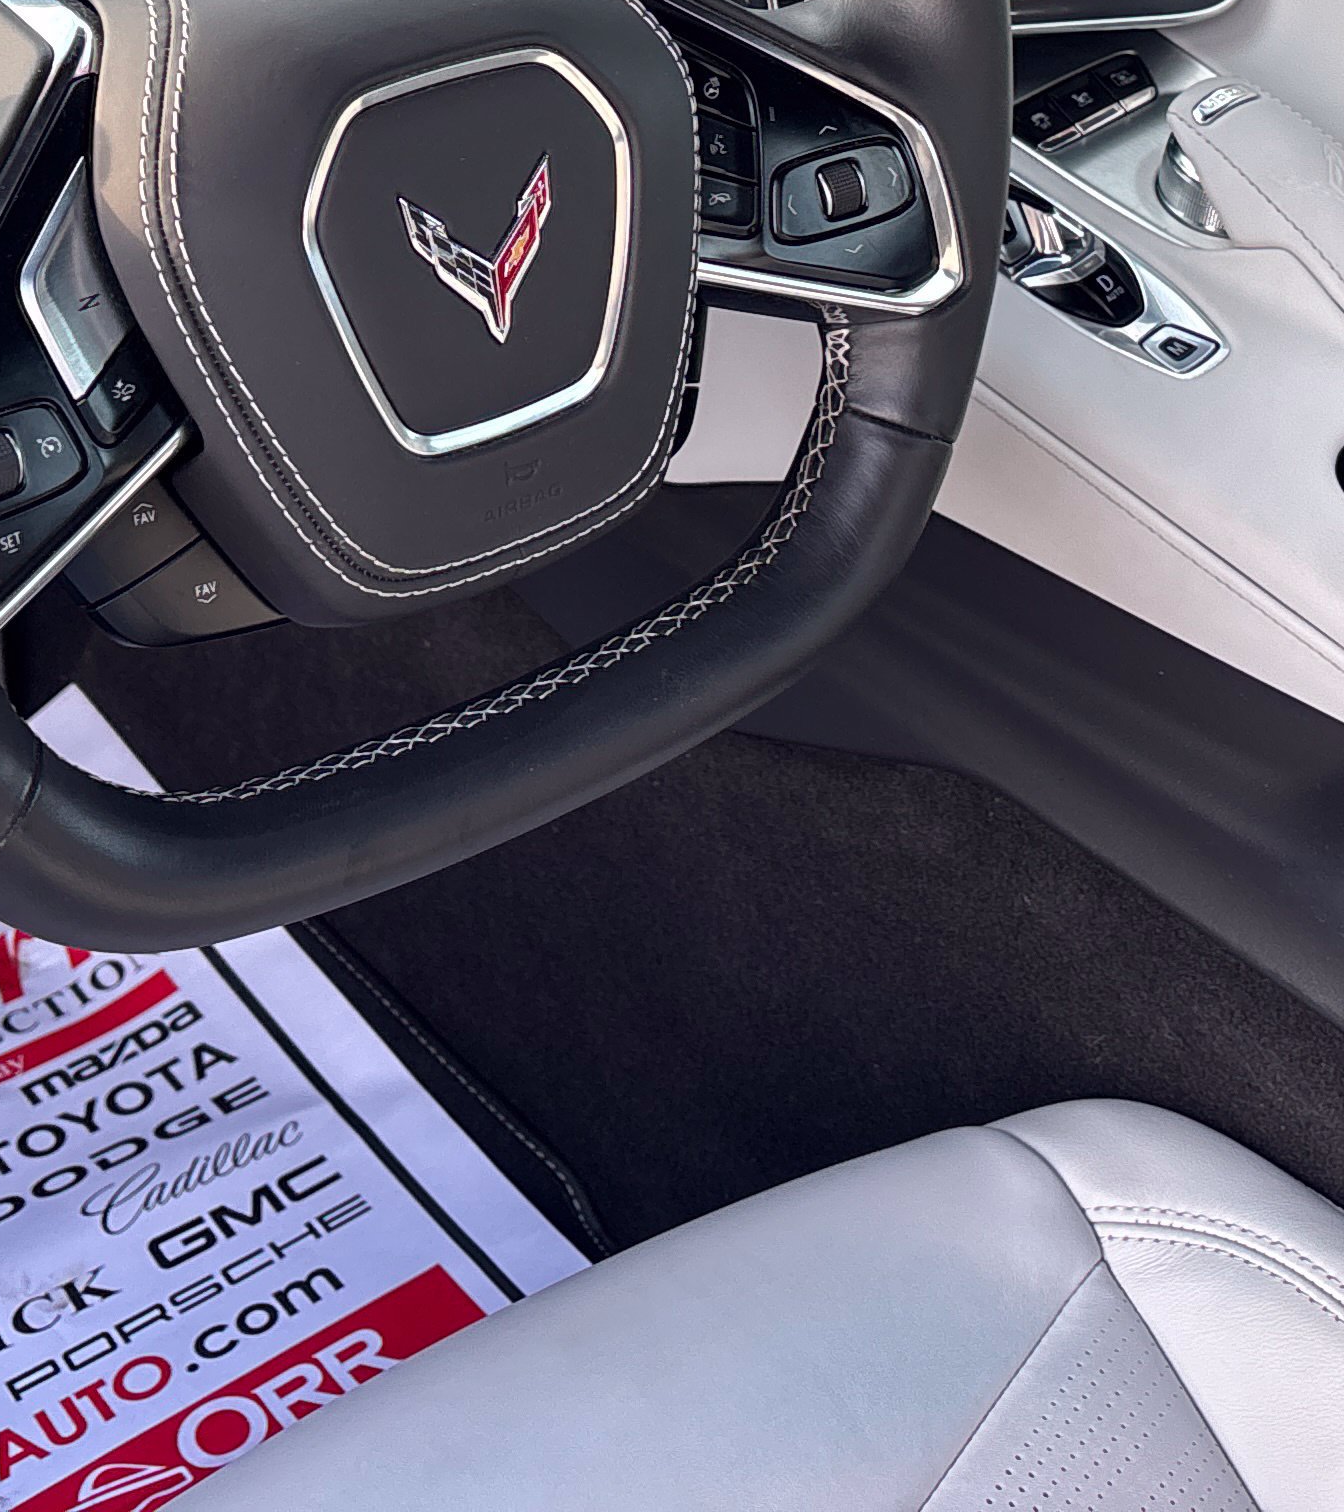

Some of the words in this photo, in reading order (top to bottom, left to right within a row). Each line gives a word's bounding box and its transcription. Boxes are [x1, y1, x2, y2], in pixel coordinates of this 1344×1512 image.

[1096, 274, 1115, 292] D
[1166, 341, 1189, 357] M
[133, 508, 157, 526] FAV
[0, 531, 22, 552] SET
[194, 580, 218, 597] FAV
[80, 1119, 304, 1236] Cadillac
[145, 1154, 346, 1270] GMC
[5, 1192, 373, 1402] PORSCHE
[176, 1327, 406, 1469] ORR
